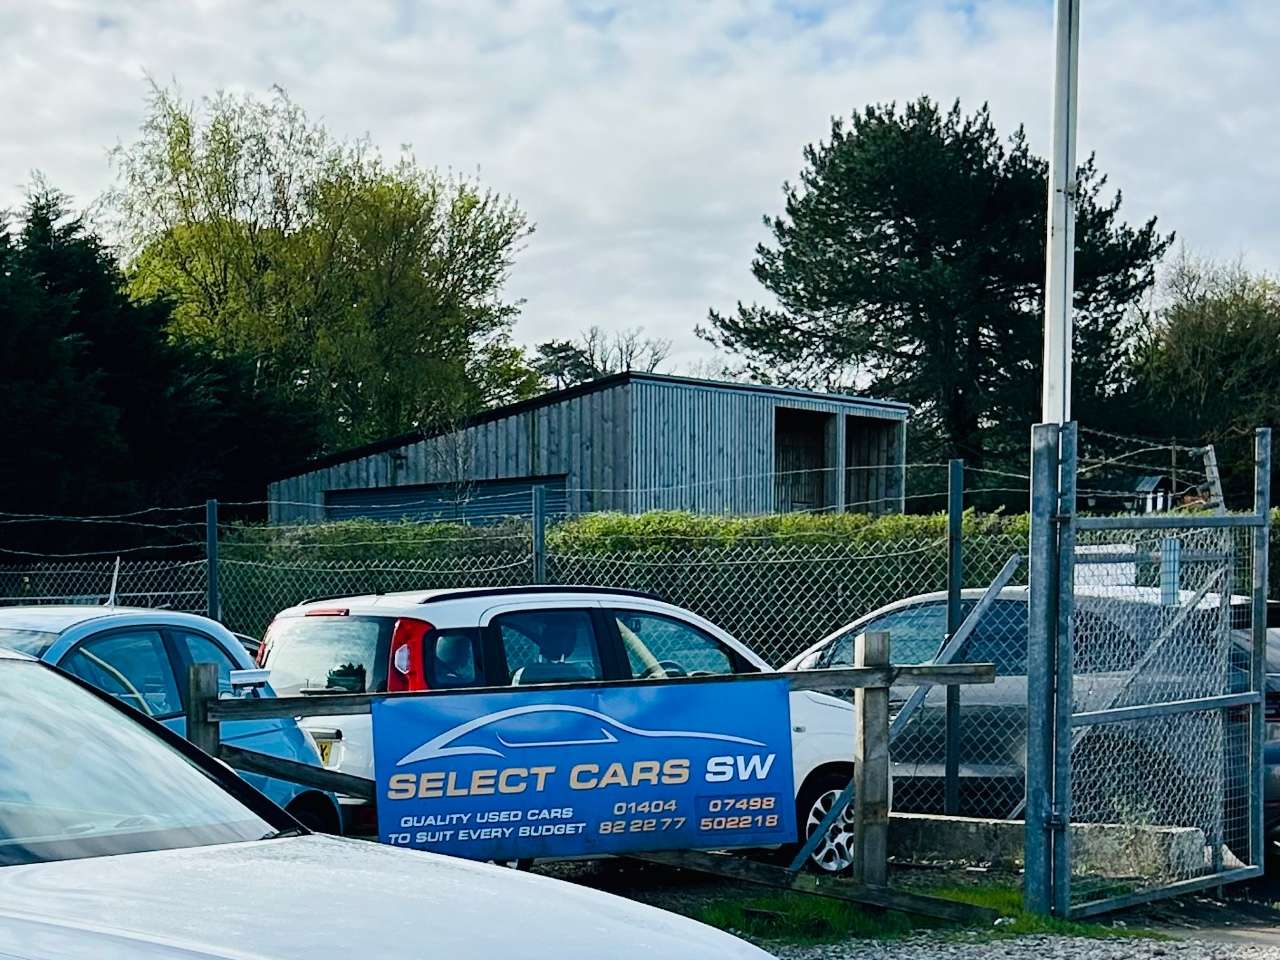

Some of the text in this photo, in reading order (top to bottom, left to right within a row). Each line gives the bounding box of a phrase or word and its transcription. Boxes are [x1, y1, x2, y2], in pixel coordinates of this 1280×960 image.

[387, 753, 776, 800] SELECT CARS SW
[613, 799, 678, 815] 01404
[709, 797, 776, 813] 07498
[400, 807, 574, 828] QUALITY USED CARS
[700, 814, 779, 831] 502218
[388, 823, 586, 845] TO SUIT EVERY BUDGET
